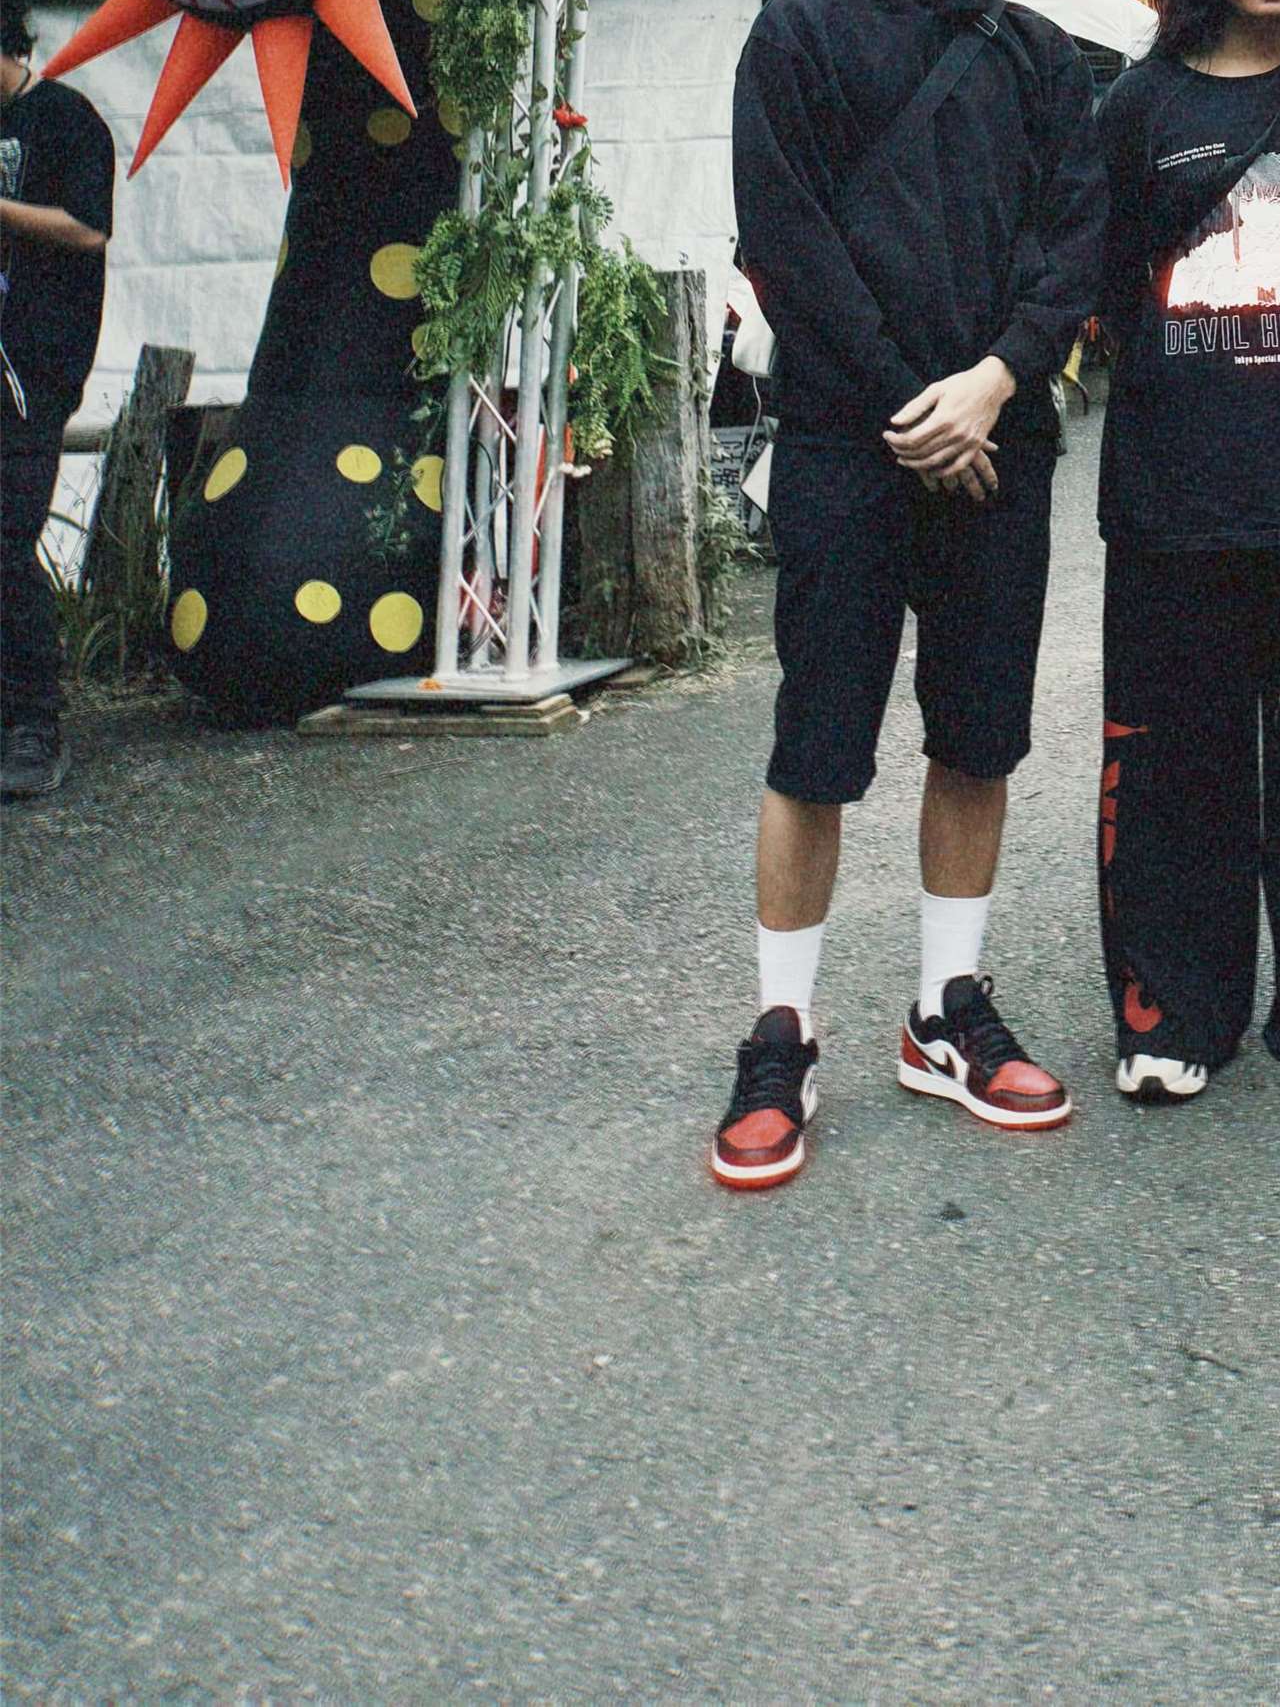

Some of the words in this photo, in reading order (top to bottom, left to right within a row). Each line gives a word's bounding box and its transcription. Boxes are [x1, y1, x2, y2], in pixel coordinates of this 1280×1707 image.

[1165, 315, 1250, 356] DEVIL
[1234, 356, 1253, 366] Tokyo
[1254, 355, 1276, 365] Special
